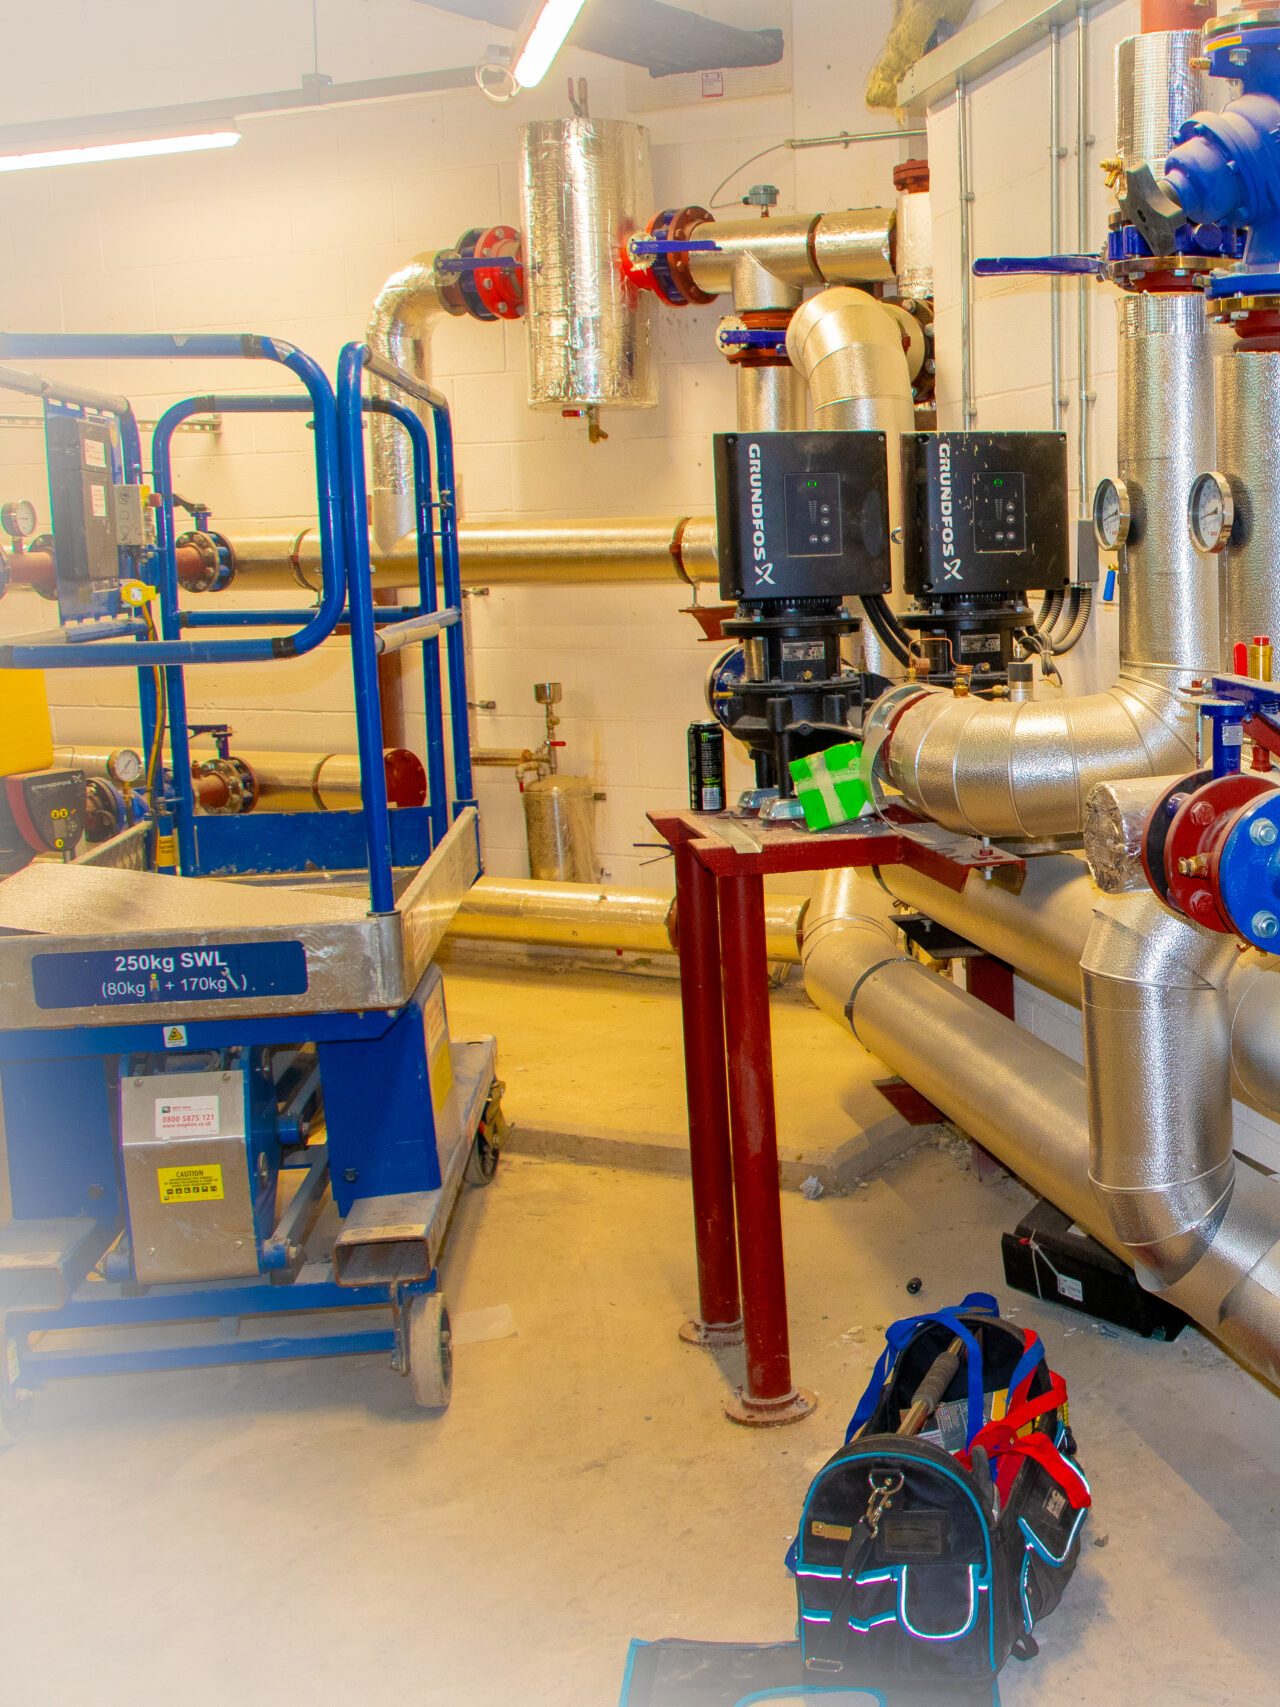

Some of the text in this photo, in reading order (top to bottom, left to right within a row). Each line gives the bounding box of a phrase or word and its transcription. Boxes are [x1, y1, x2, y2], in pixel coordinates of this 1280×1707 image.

[748, 443, 767, 561] GRUNDFOS
[938, 443, 956, 557] GRUNDFOS
[31, 780, 72, 791] GRUNDFOS
[114, 950, 228, 973] 250kg SWL
[101, 981, 146, 998] (80kg
[180, 976, 228, 993] 170kg
[163, 1115, 180, 1123] 0800
[176, 1169, 204, 1178] CAUTION
